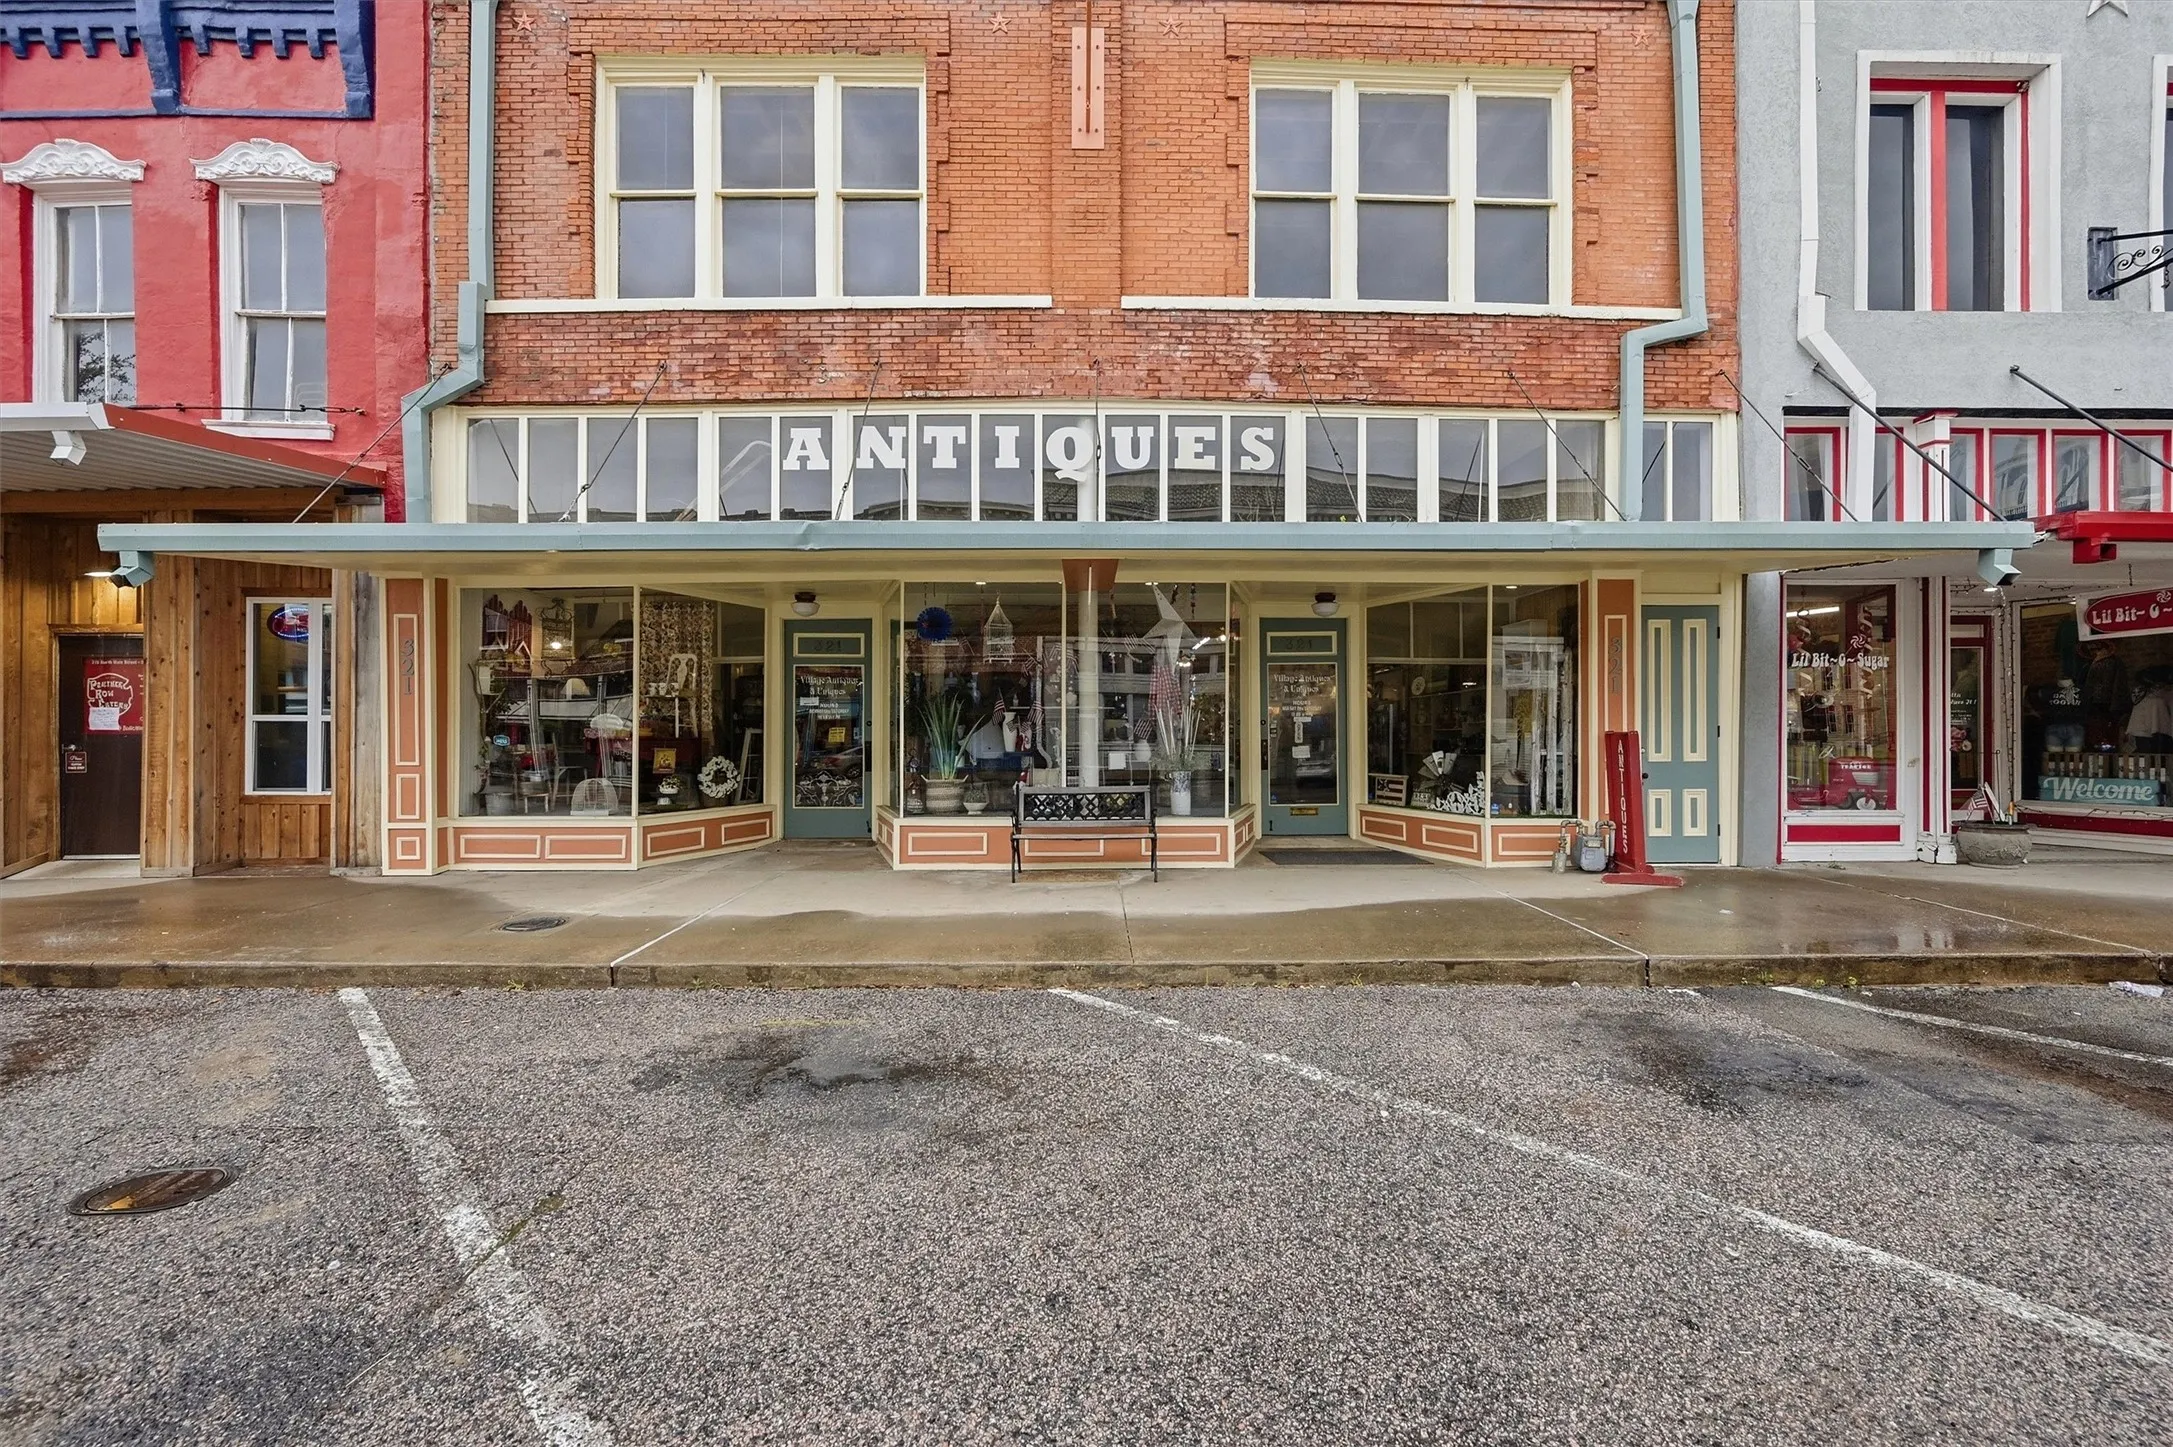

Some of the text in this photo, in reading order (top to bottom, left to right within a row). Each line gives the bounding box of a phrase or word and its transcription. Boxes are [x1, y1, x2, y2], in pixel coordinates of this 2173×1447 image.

[782, 425, 1275, 482] ANTIQUES
[2092, 609, 2112, 624] Lil
[813, 639, 842, 652] 321
[1285, 638, 1313, 651] 321
[401, 639, 415, 696] 321
[1609, 636, 1622, 694] 321
[1791, 653, 1809, 667] Lil
[800, 676, 858, 686] Village Antiques
[1273, 674, 1330, 684] Village Antiques
[1617, 740, 1628, 854] ANTIQUES
[2043, 778, 2154, 801] Welcome
